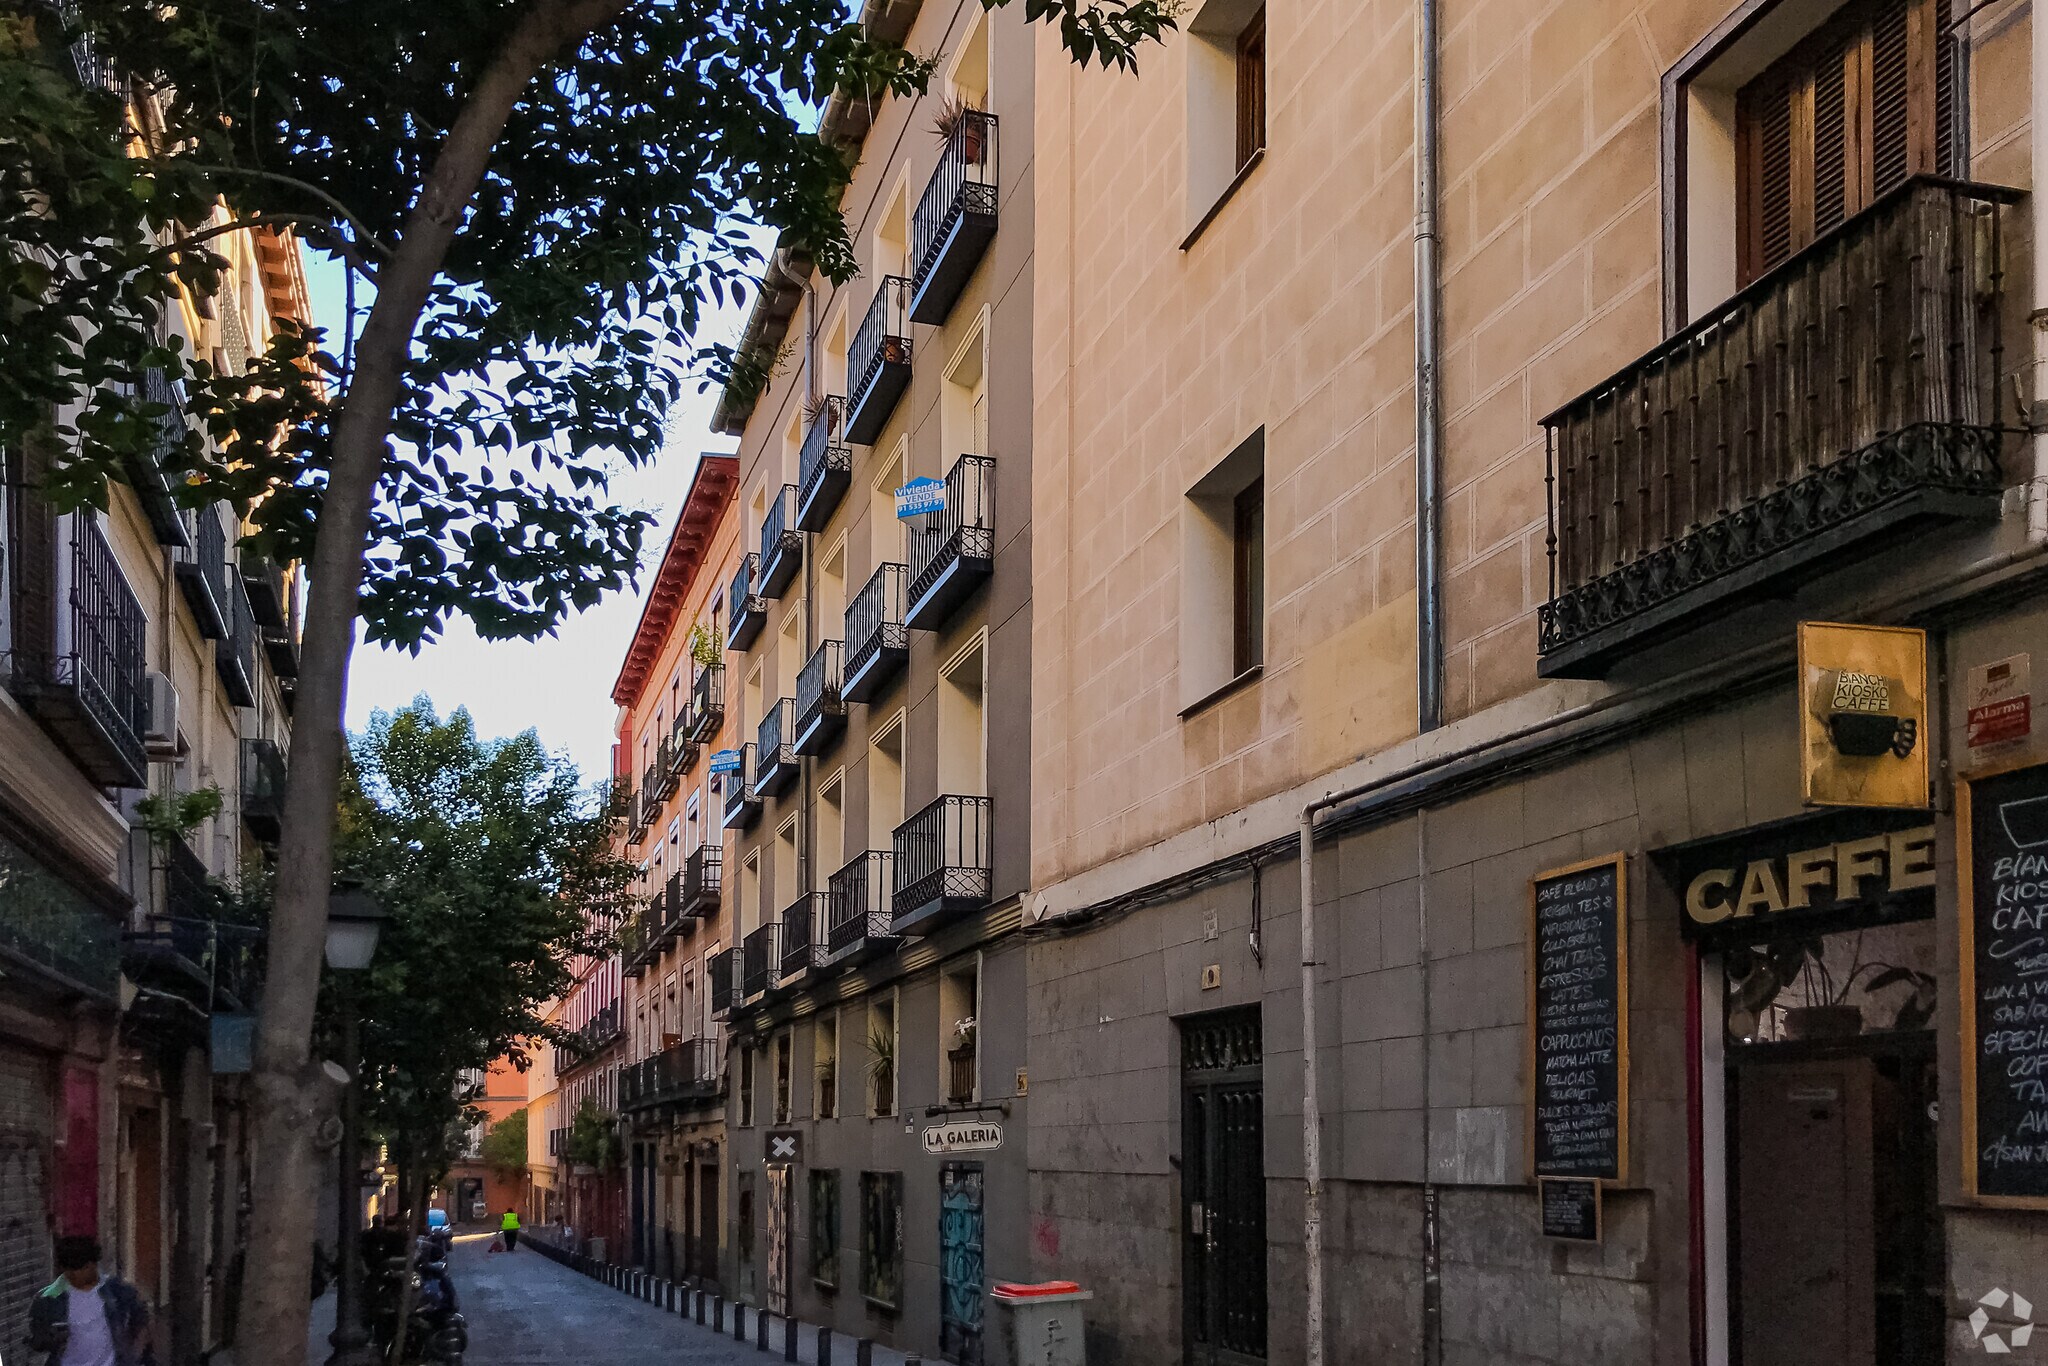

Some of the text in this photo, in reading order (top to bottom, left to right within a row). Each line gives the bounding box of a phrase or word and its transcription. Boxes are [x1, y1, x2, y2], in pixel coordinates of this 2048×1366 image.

[898, 504, 907, 513] 91
[923, 500, 933, 508] 97
[934, 498, 943, 506] 97
[905, 491, 936, 503] VENDE
[1836, 683, 1889, 699] KIOSKO
[1833, 696, 1888, 711] CAFFE
[1973, 700, 2025, 721] Alarma
[1686, 825, 1936, 924] CAFFE
[2017, 982, 2028, 999] A
[1544, 1069, 1596, 1086] DELICIAS
[927, 1128, 999, 1146] LA GALERIA
